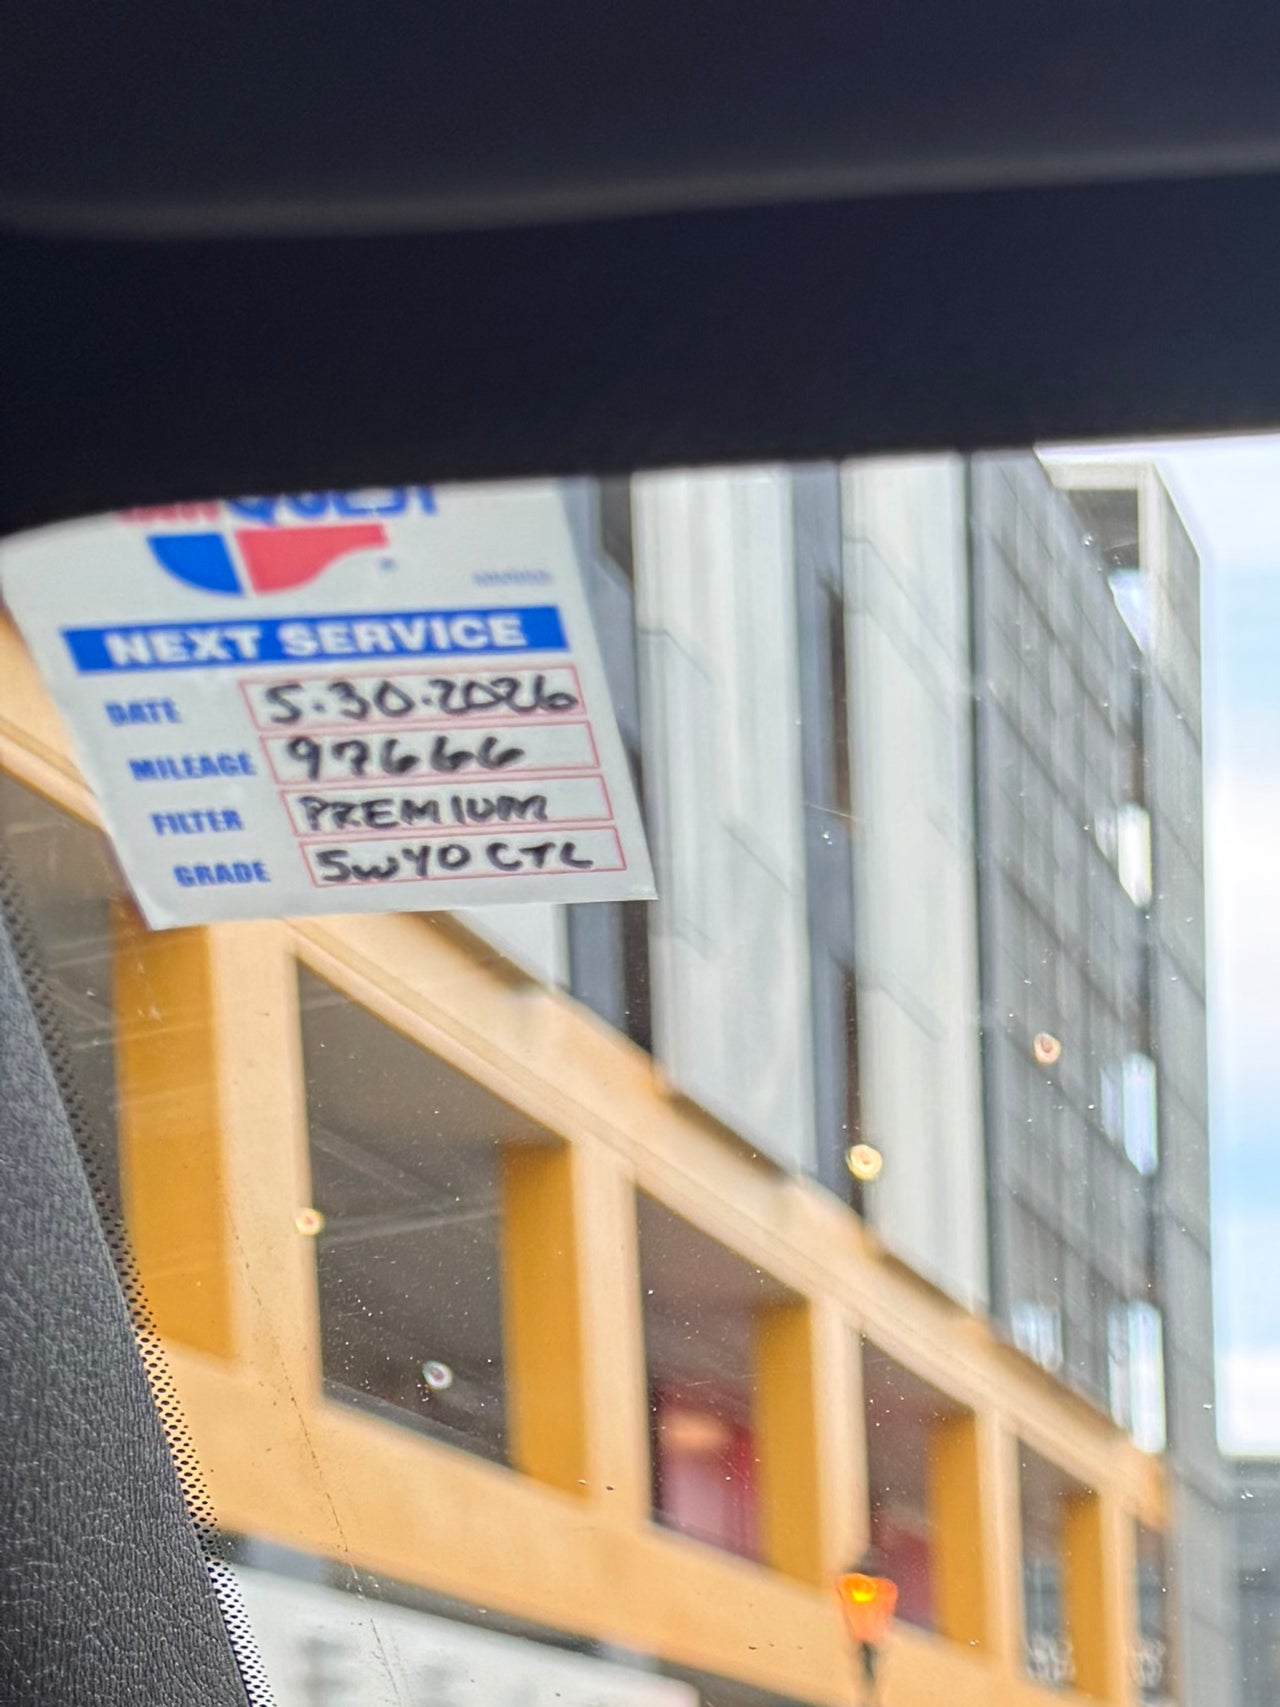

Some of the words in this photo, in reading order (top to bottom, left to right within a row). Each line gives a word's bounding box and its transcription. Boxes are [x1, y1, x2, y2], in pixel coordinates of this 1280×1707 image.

[102, 627, 262, 667] NEXT
[277, 613, 528, 658] SERVICE
[105, 698, 182, 727] DATE
[264, 673, 579, 724] 5.30.2026
[128, 752, 256, 782] MILEAGE
[150, 808, 243, 836] FILTER
[299, 793, 549, 831] PREMIUM
[173, 861, 271, 888] GRADE
